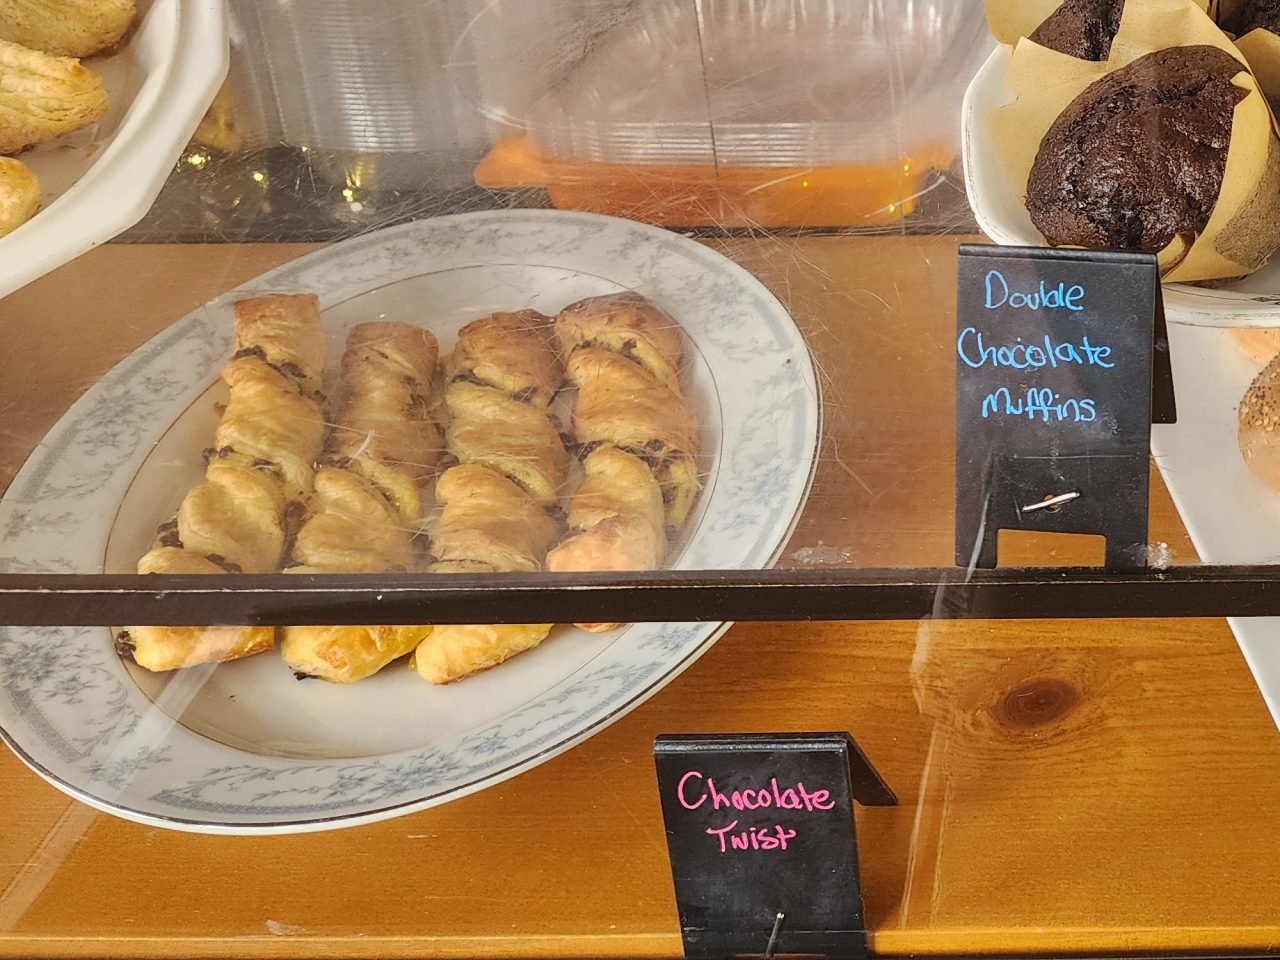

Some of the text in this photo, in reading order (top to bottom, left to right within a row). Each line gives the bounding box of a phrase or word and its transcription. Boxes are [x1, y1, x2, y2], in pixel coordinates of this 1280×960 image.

[984, 270, 1085, 311] Double
[957, 327, 1116, 369] Chocolate
[677, 771, 836, 813] Chocolate
[705, 820, 797, 853] Twist
